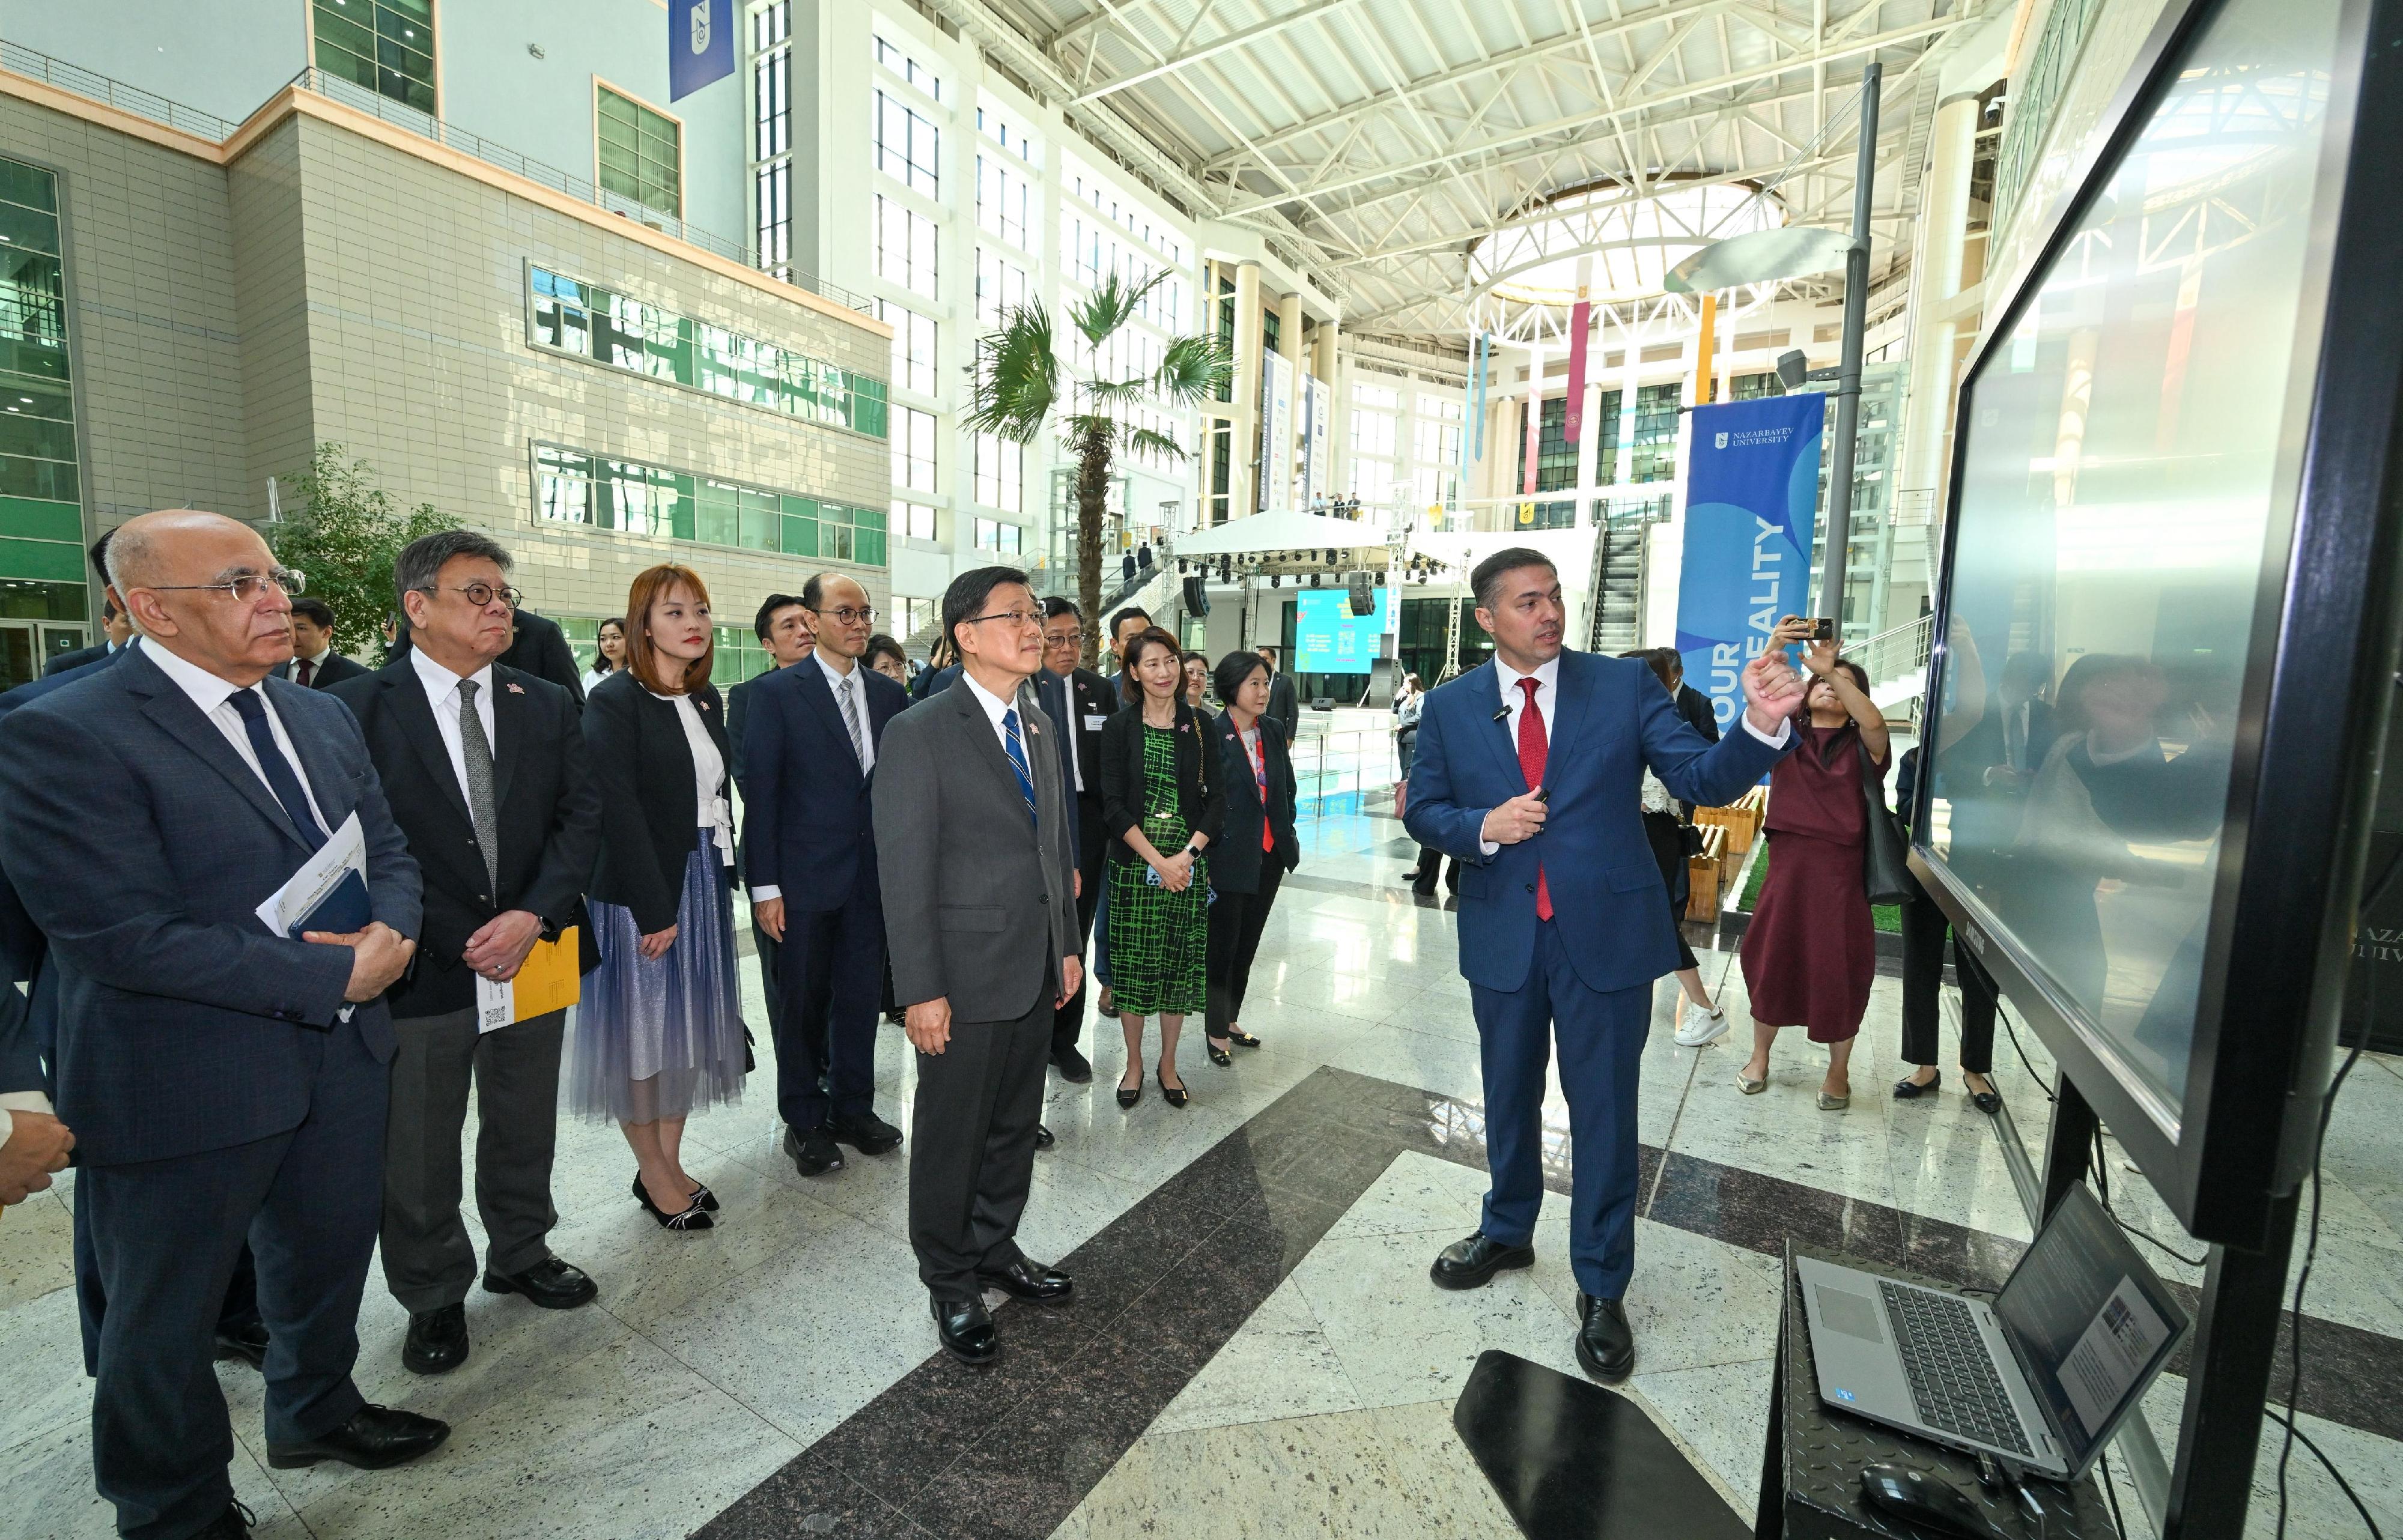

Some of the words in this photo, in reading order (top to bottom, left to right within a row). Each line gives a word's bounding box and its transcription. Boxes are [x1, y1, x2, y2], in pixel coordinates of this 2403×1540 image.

[1733, 427, 1794, 439] NAZARBAYEV
[1733, 435, 1790, 446] UNIVERSITY
[1745, 515, 1784, 659] EALITY
[1710, 643, 1740, 741] OUR
[1966, 921, 1984, 954] SAMSUNG
